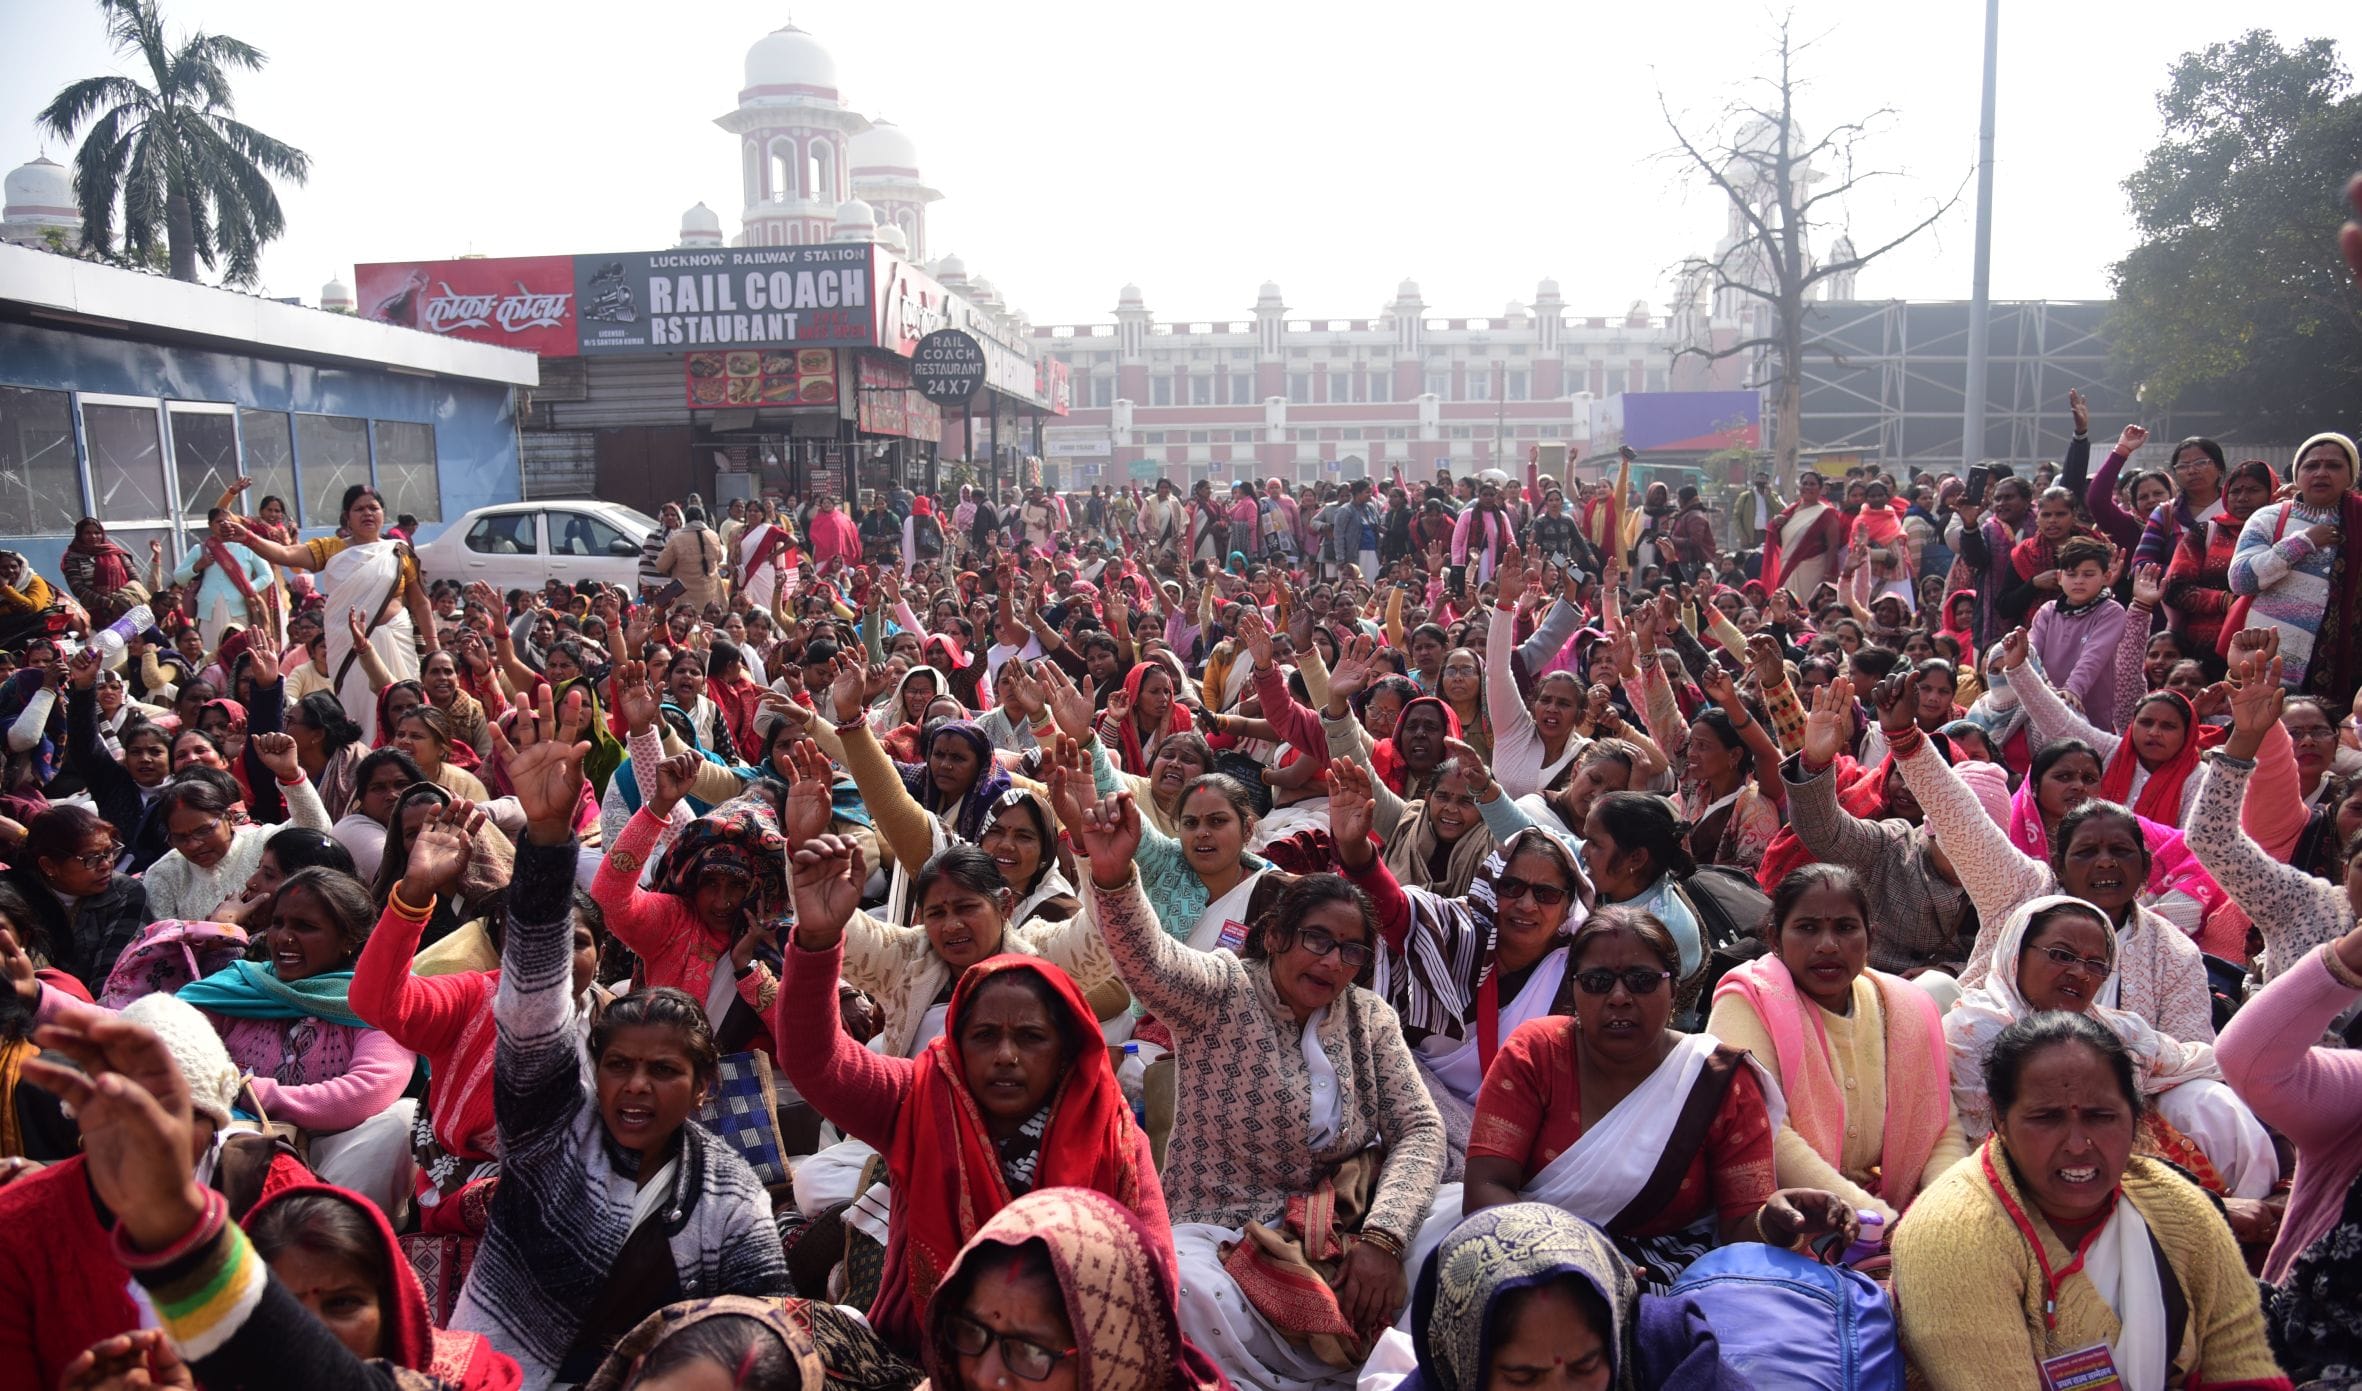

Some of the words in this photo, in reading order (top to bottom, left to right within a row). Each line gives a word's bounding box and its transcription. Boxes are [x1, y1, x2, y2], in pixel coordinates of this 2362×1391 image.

[651, 255, 725, 268] LUCKNOW
[734, 252, 796, 265] RAILWAY
[804, 249, 865, 262] STATION
[649, 273, 737, 314] RAIL
[745, 269, 865, 310] COACH
[651, 313, 798, 345] RSTAURANT
[932, 336, 965, 347] RAIL
[923, 349, 975, 360] COACH
[915, 363, 982, 375] RESTAURANT
